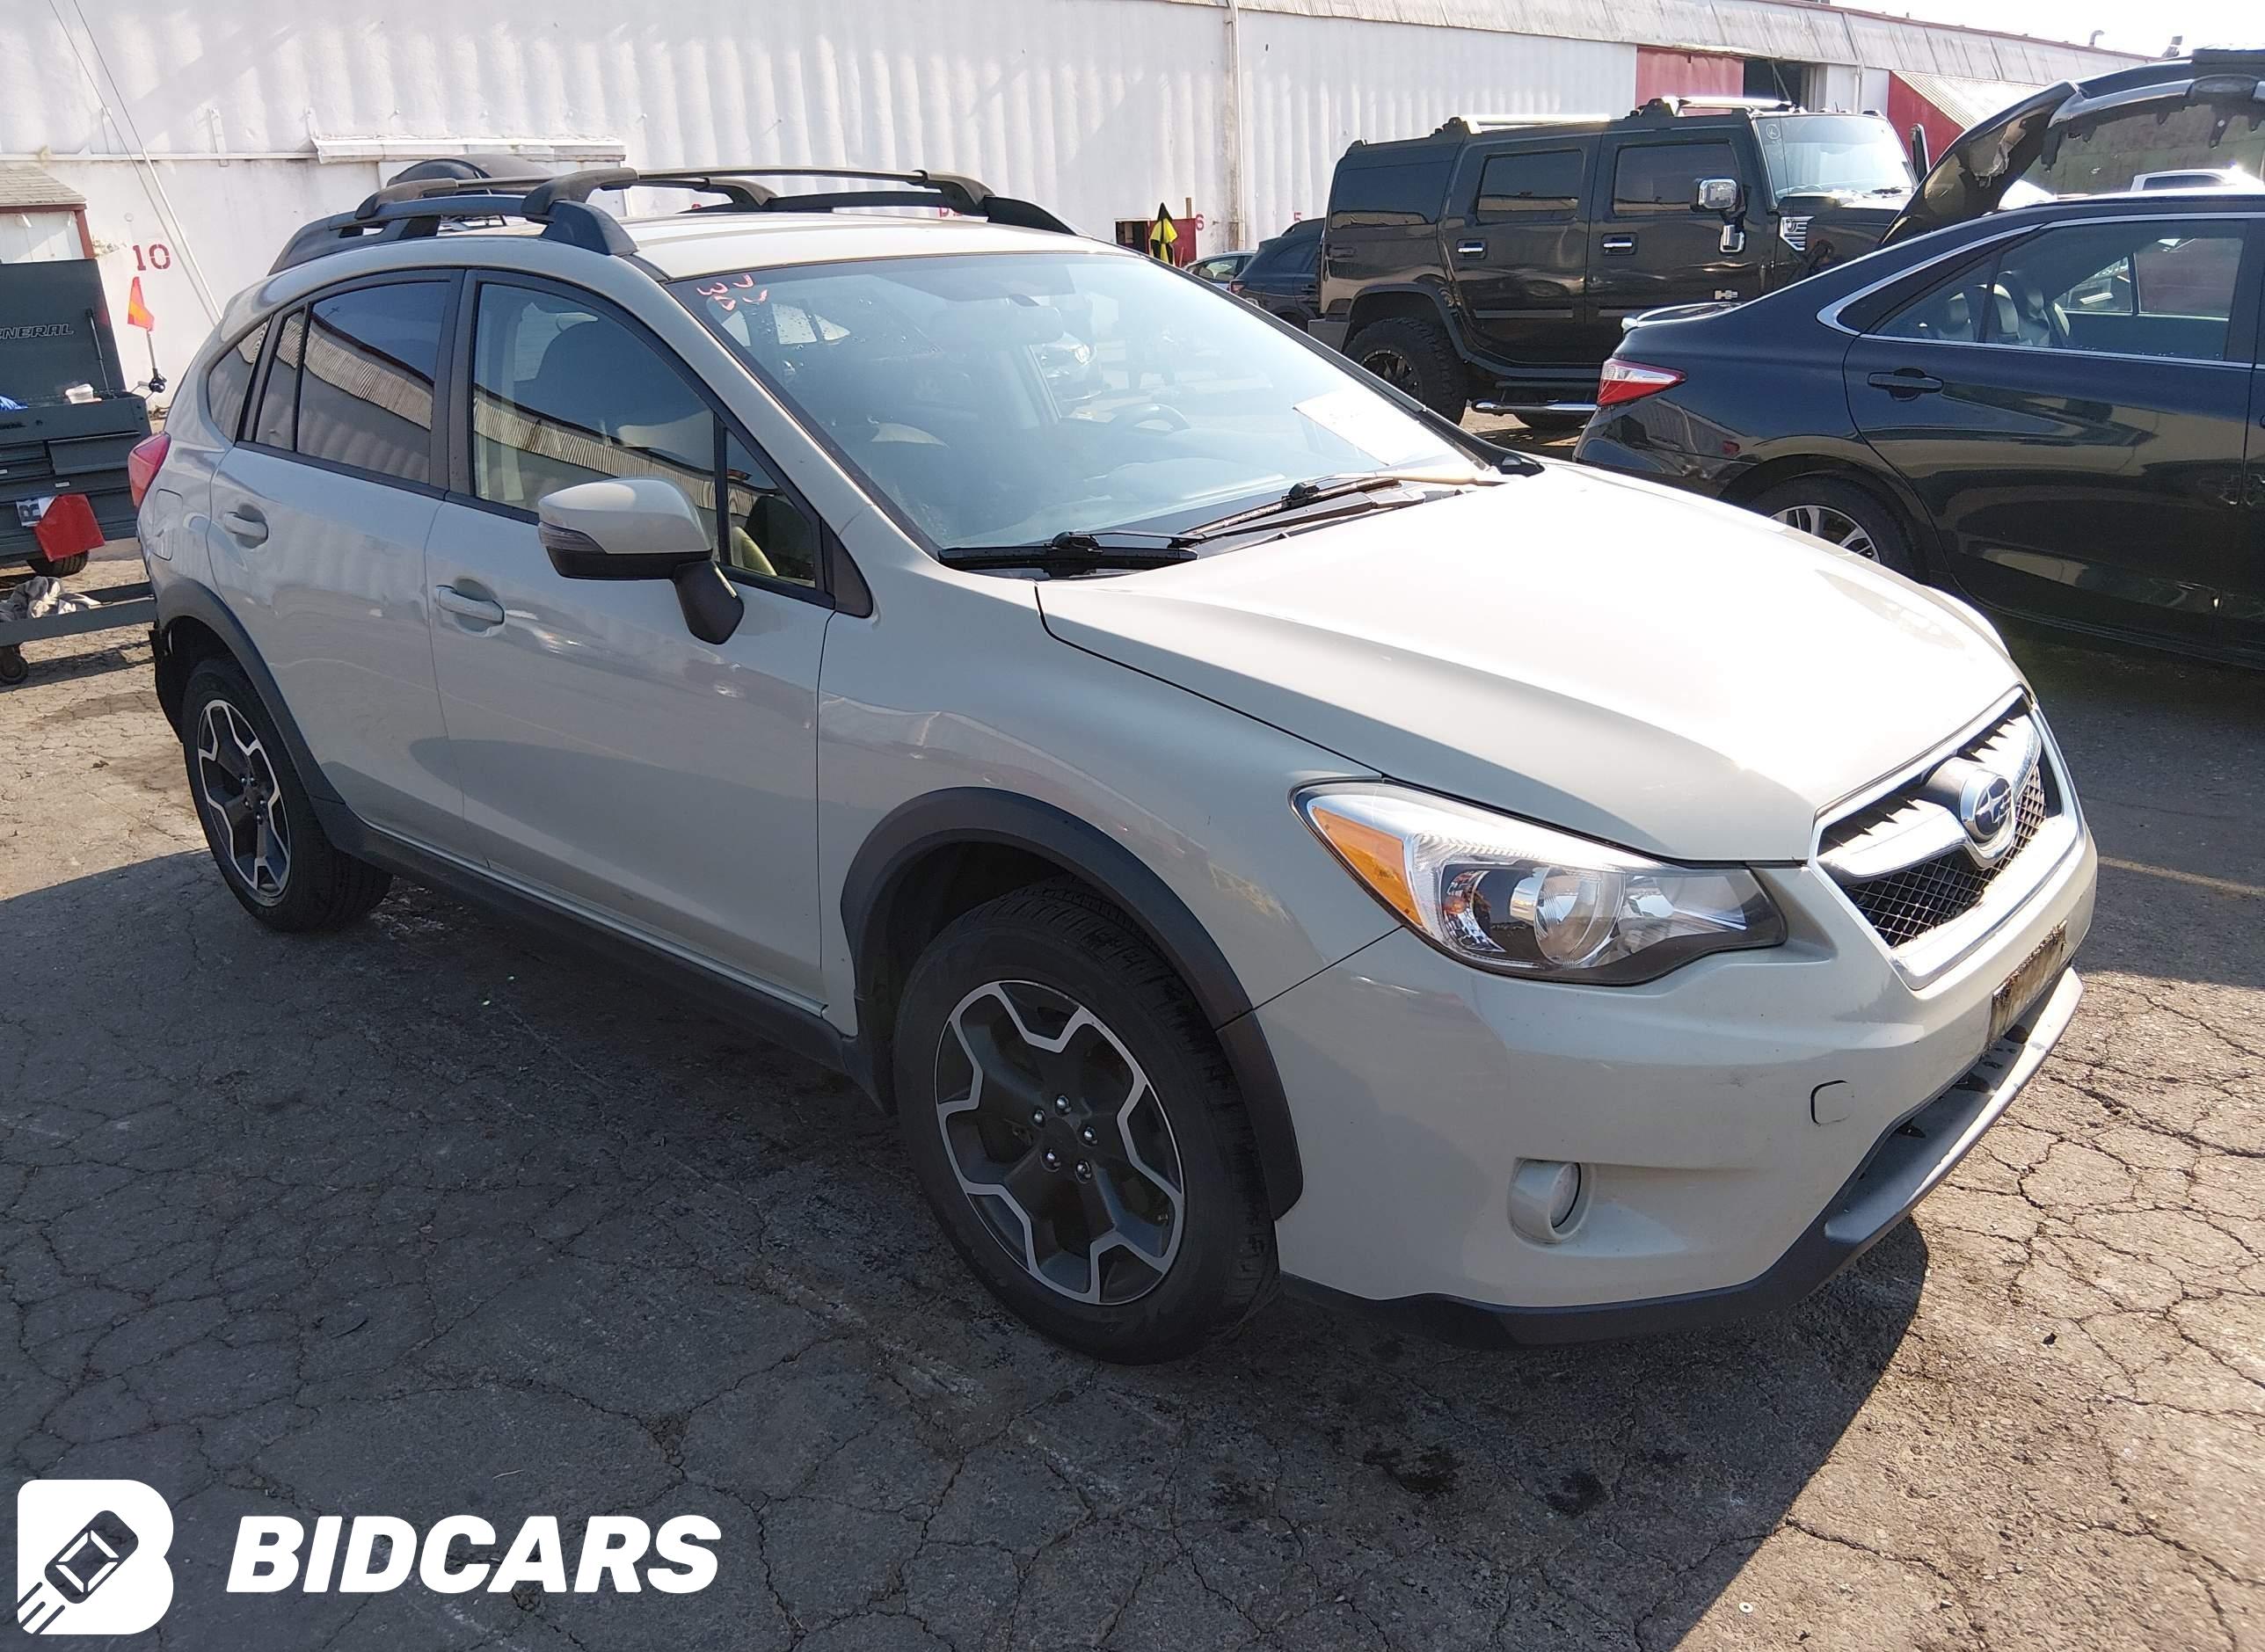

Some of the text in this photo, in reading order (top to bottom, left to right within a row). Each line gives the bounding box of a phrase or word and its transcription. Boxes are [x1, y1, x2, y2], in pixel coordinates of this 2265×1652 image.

[1196, 214, 1205, 231] 6
[132, 244, 171, 272] 10
[0, 324, 75, 339] NERAL
